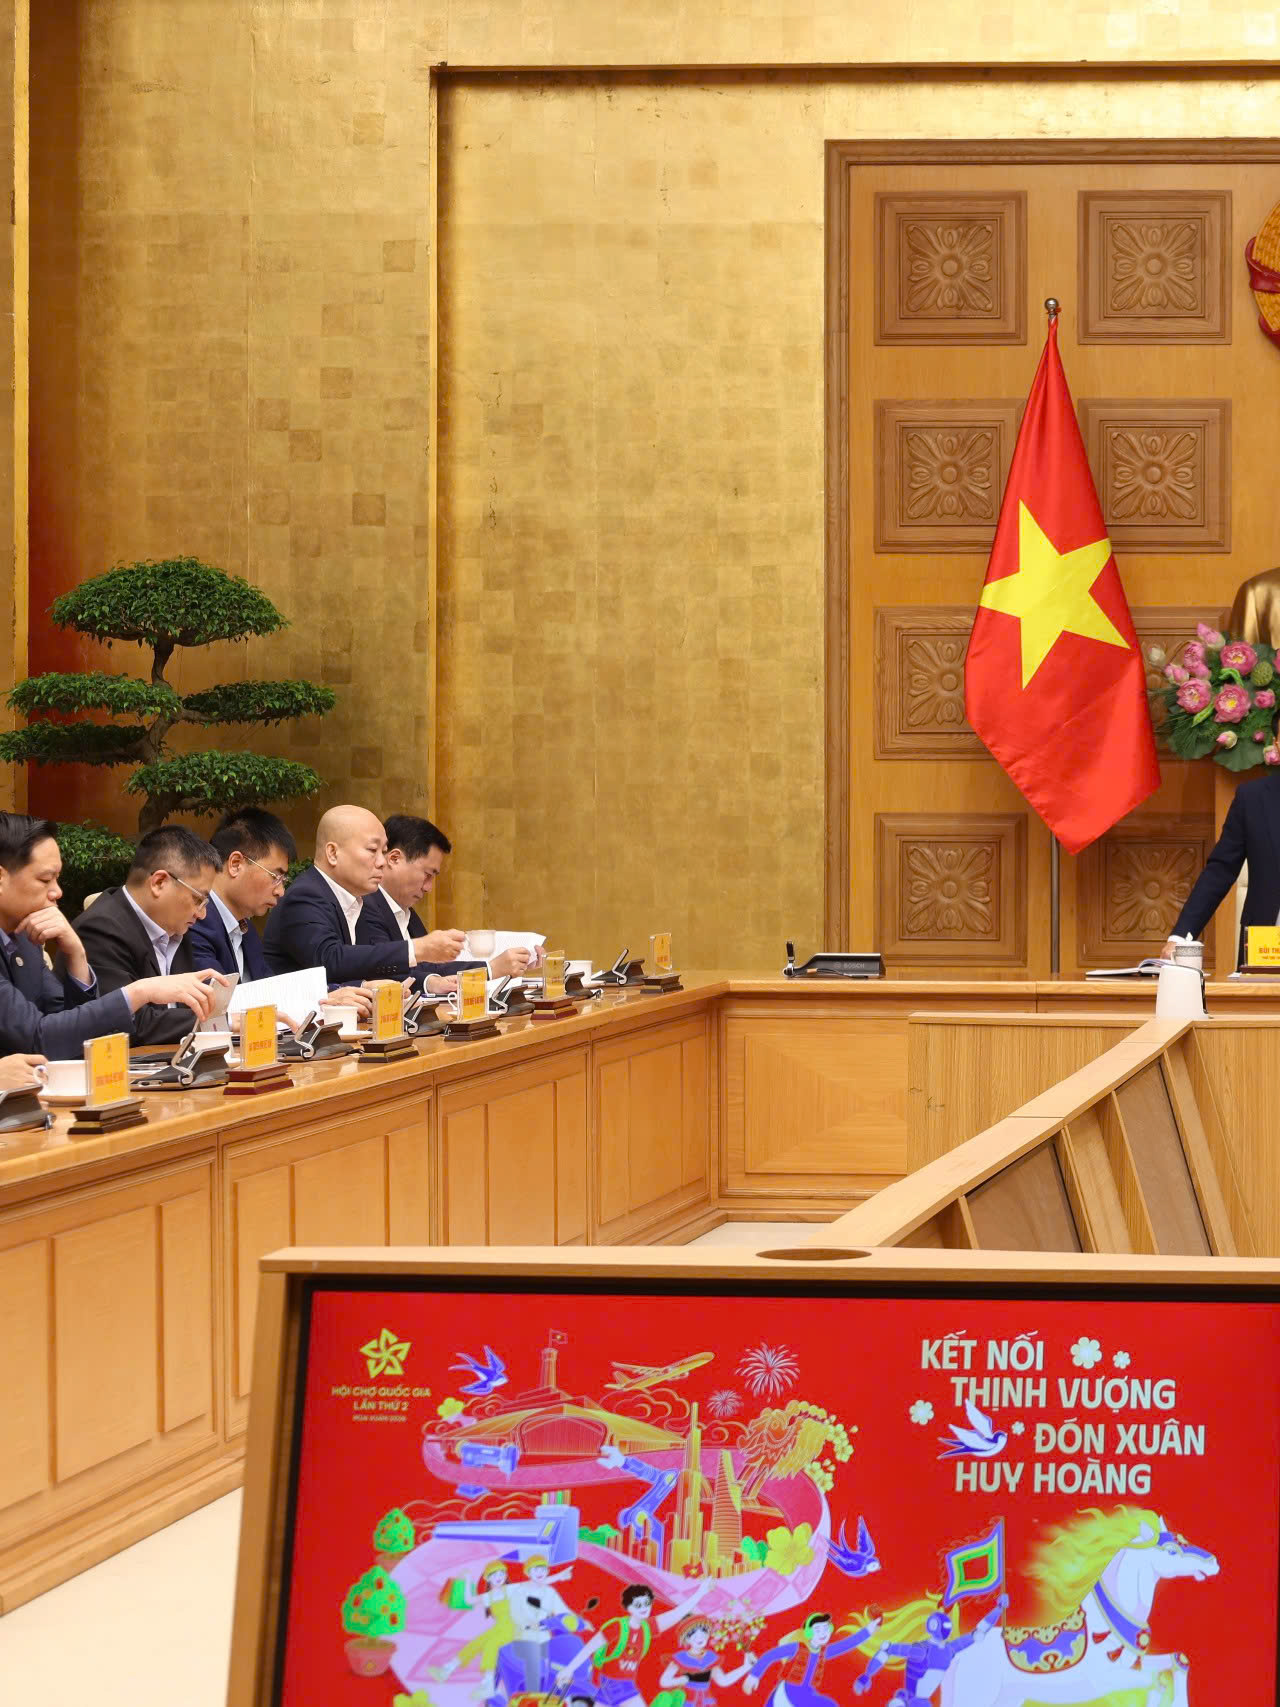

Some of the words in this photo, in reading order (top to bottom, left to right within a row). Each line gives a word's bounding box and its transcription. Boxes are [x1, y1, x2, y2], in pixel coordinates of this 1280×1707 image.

[921, 1329, 977, 1369] KẾT
[987, 1330, 1044, 1370] NỐI
[331, 1384, 350, 1397] HỘI
[352, 1386, 377, 1398] CHỢ
[378, 1384, 411, 1397] QUỐC
[412, 1387, 432, 1397] GIA
[378, 1399, 401, 1411] THỨ
[401, 1401, 409, 1411] 2
[950, 1376, 1047, 1411] THỊNH
[1058, 1375, 1176, 1413] VƯỢNG
[1034, 1417, 1105, 1454] ĐÓN
[1115, 1418, 1205, 1455] XUÂN
[955, 1462, 1025, 1493] HUY
[1033, 1457, 1152, 1495] HOÀNG
